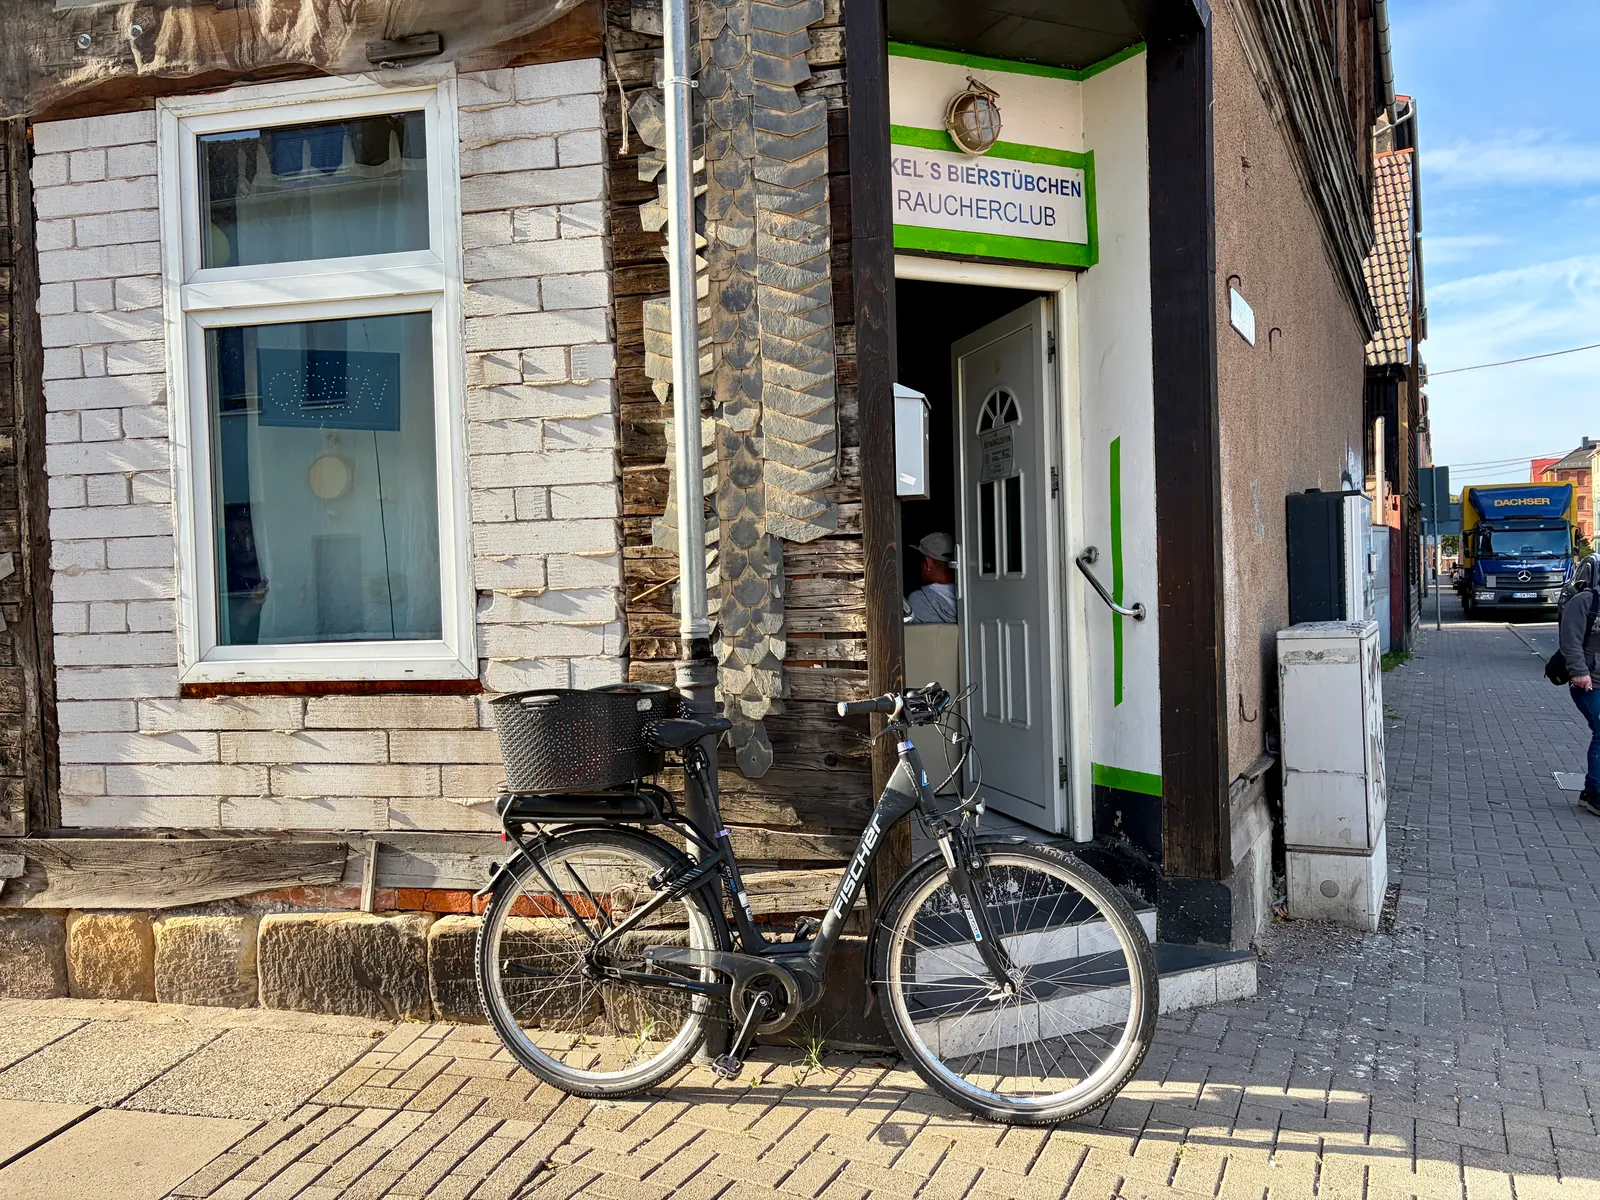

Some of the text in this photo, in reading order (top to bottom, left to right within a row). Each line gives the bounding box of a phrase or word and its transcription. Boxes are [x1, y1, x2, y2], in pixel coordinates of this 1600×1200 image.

[947, 164, 1082, 197] BIERSTÜBCHEN
[897, 189, 1056, 227] RAUCHERCLUB
[1494, 497, 1551, 507] DACHSER
